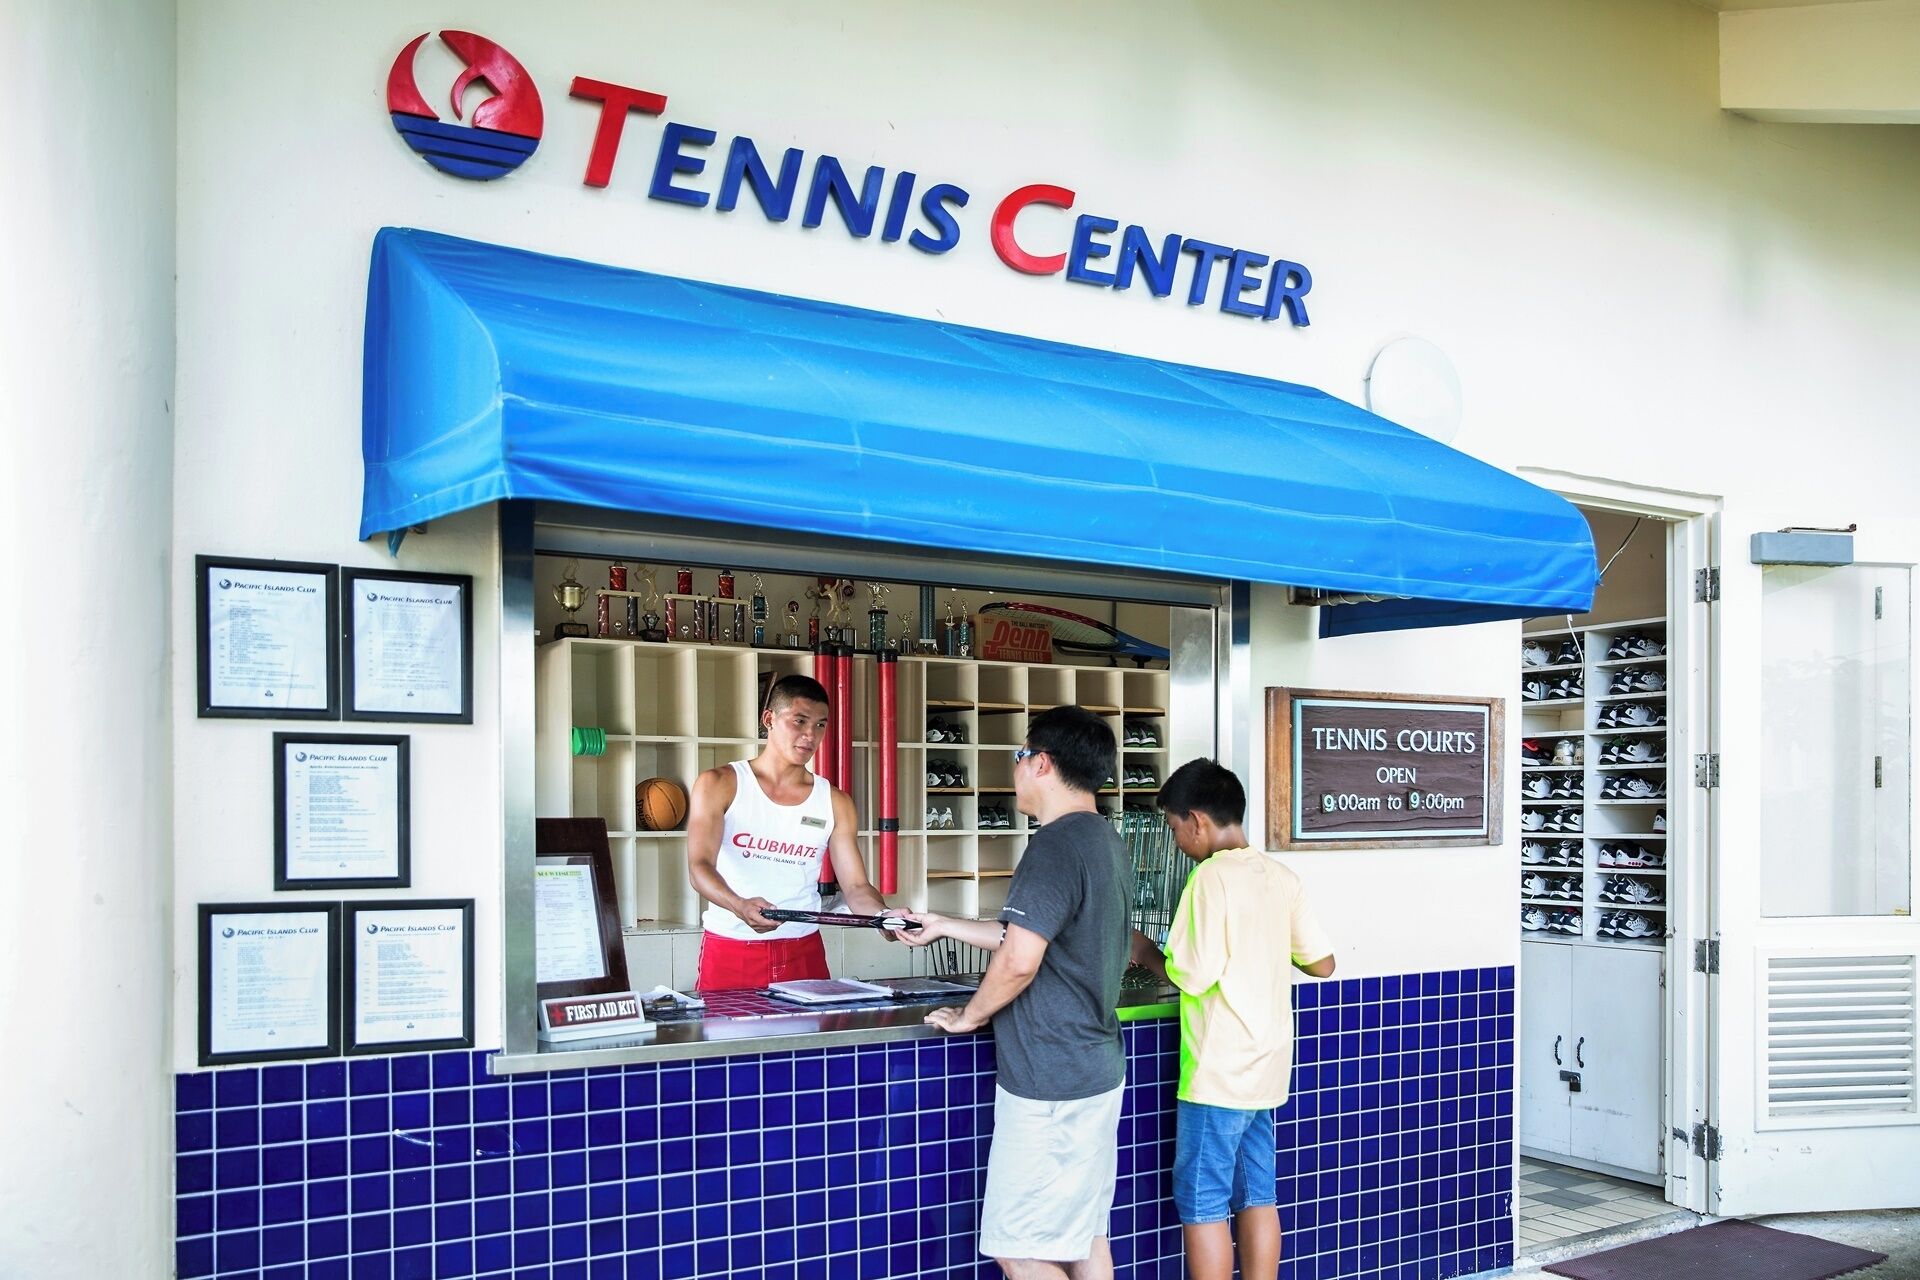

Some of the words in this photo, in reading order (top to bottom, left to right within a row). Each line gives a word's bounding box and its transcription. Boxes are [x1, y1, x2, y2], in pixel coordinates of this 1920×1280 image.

[568, 76, 970, 255] TENNIS
[989, 183, 1312, 328] CENTER
[234, 582, 262, 590] PACIFIC
[264, 584, 295, 592] ISLANDS
[296, 585, 317, 593] CLUB
[1311, 727, 1388, 751] TENNIS
[1396, 729, 1476, 753] COURTS
[368, 754, 388, 762] CLUB
[1376, 766, 1417, 784] OPEN
[1323, 794, 1381, 812] 9:00am
[1387, 795, 1402, 810] to
[1409, 791, 1464, 813] 9:00pm
[732, 832, 818, 858] CLUBMATE
[752, 853, 771, 861] PACIFIC
[773, 857, 796, 865] ISLANDS
[565, 1003, 598, 1021] FIRST
[599, 1001, 617, 1018] AID
[617, 999, 636, 1016] KIT
